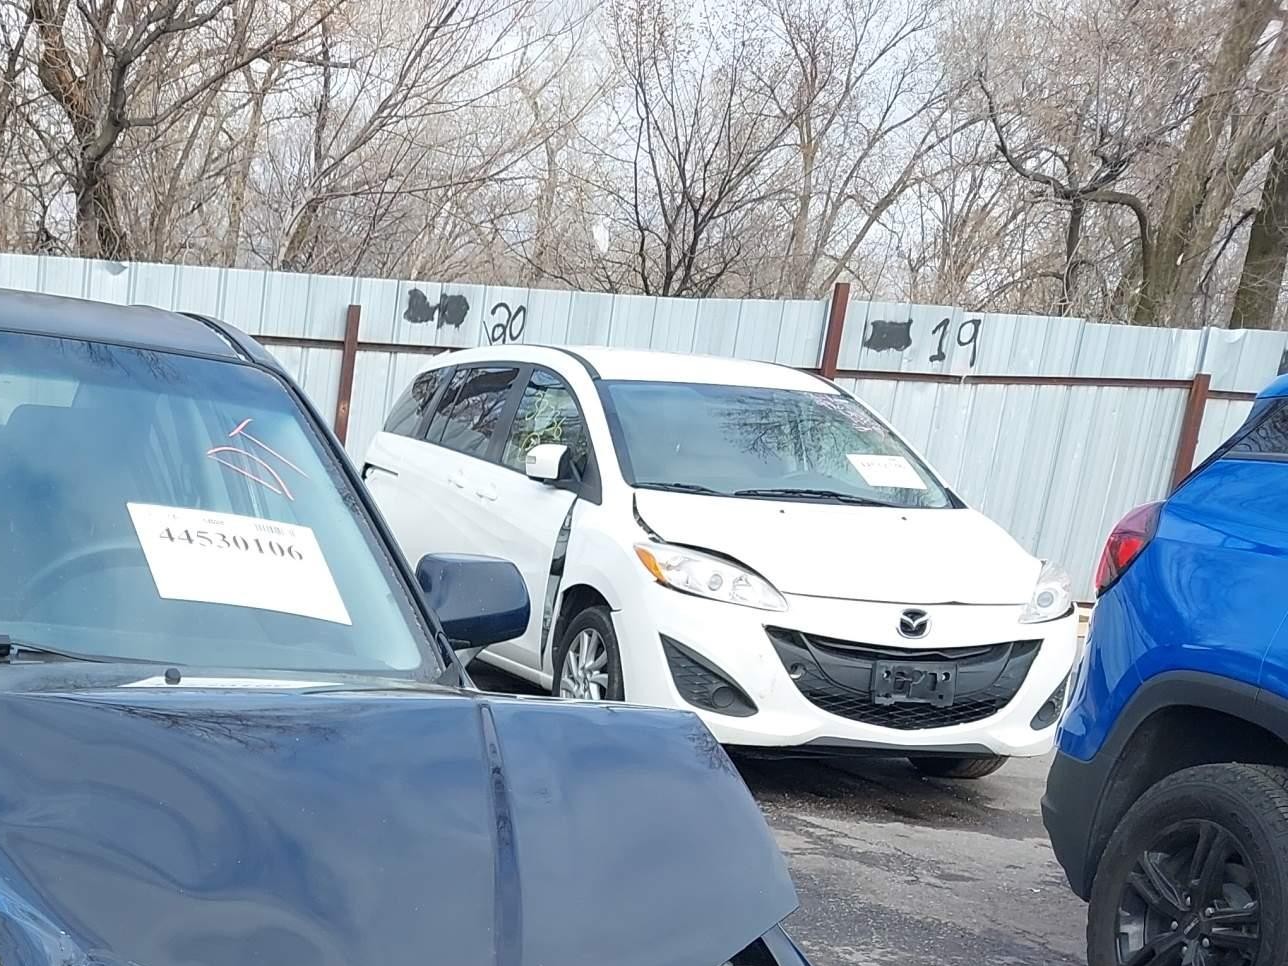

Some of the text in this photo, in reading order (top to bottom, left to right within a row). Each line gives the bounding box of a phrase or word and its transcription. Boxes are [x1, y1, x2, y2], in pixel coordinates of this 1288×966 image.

[490, 302, 527, 345] 20
[929, 317, 982, 368] 19
[159, 527, 304, 561] 44530106
